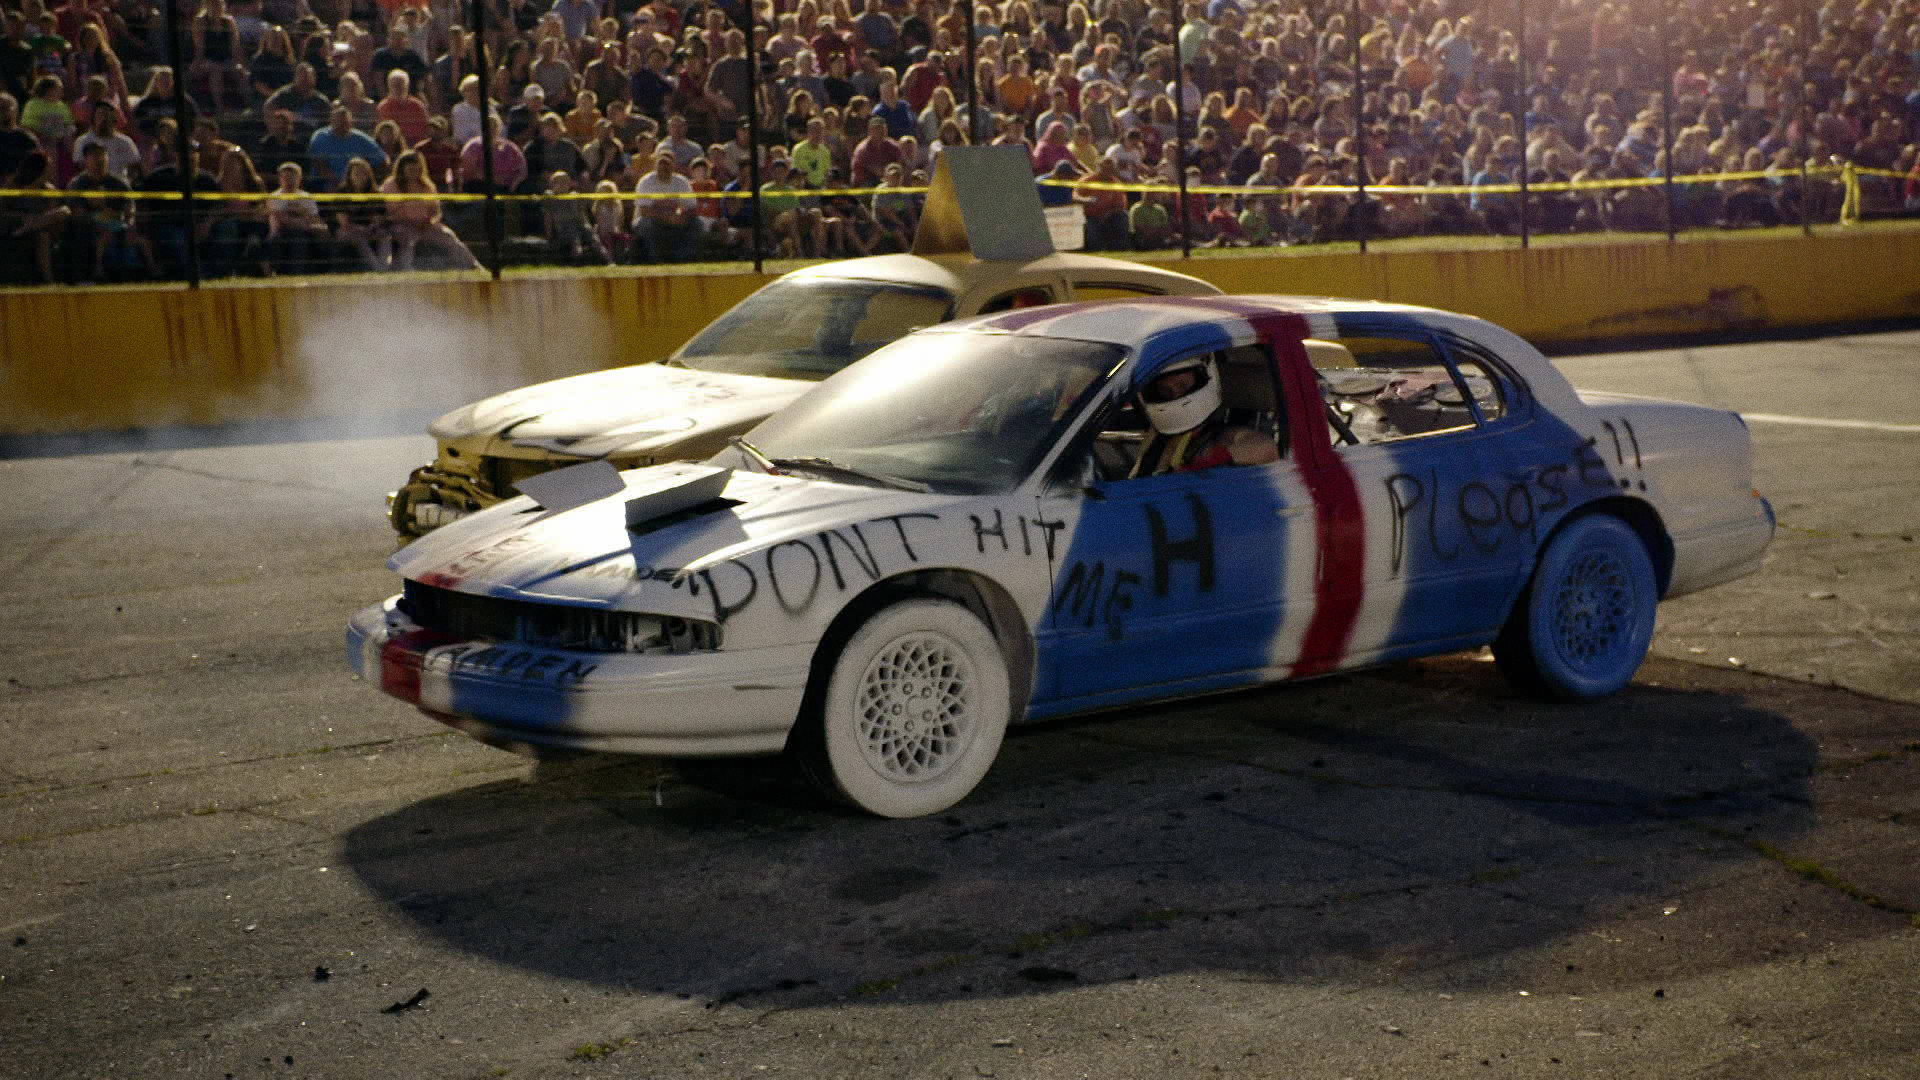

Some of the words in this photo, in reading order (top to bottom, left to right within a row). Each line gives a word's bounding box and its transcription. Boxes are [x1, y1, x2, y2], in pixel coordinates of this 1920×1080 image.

[699, 512, 939, 622] DONT
[969, 508, 1065, 561] HIT
[1055, 560, 1144, 641] ME
[1148, 492, 1216, 596] H
